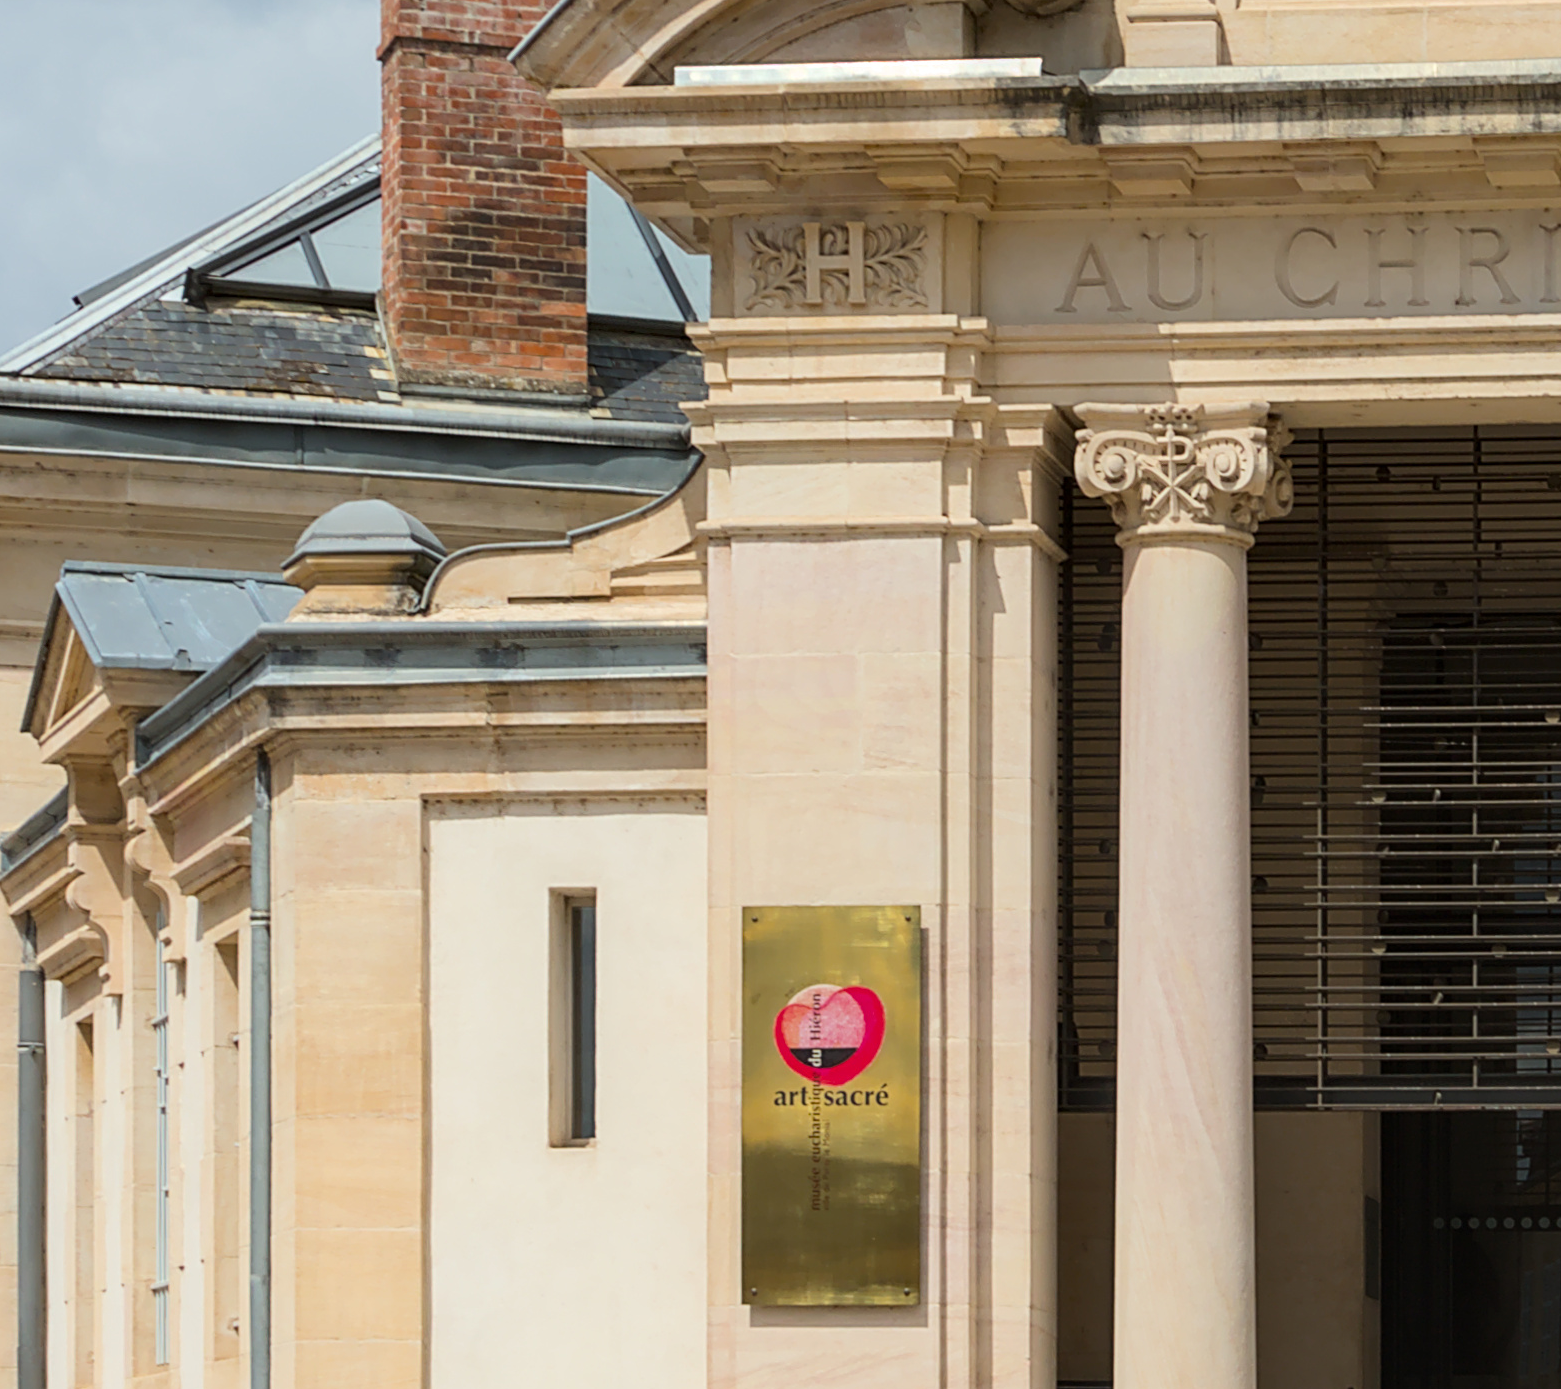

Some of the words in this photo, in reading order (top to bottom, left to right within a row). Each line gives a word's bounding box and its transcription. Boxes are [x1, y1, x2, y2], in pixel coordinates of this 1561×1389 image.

[802, 221, 866, 304] H
[1054, 231, 1208, 311] AU
[808, 993, 822, 1041] Hiéron
[808, 1049, 822, 1068] du
[774, 1088, 809, 1107] art
[823, 1082, 889, 1107] sacré
[809, 1167, 822, 1211] musée
